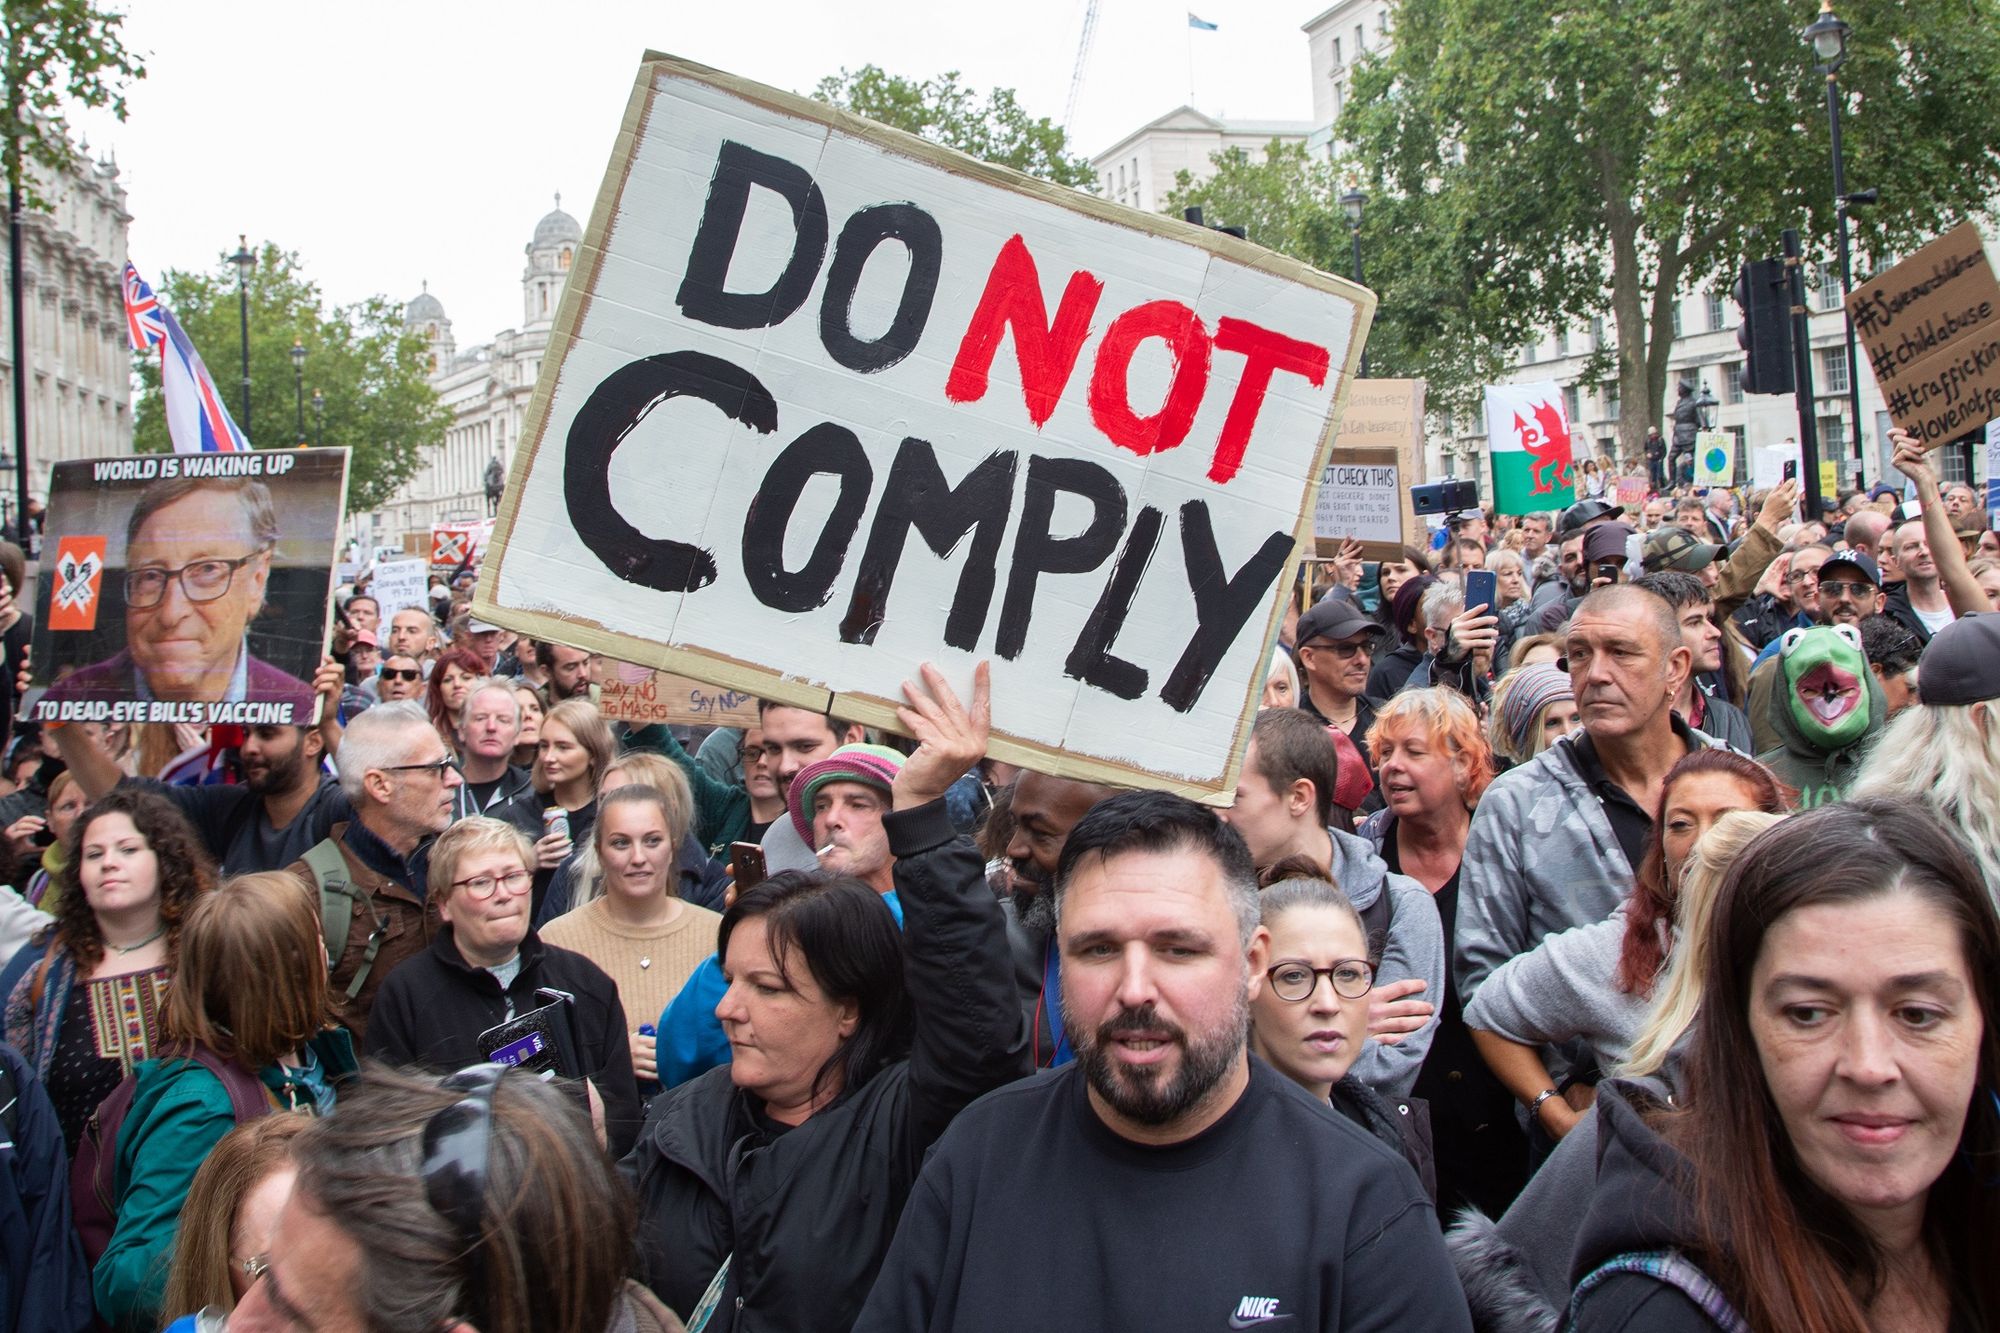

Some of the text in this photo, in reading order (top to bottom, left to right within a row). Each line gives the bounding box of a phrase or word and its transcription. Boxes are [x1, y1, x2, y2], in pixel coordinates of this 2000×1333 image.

[676, 140, 1330, 485] DO NOT
[1871, 302, 1993, 381] #childabuse
[1888, 342, 2000, 420] #traffickin
[1904, 388, 2000, 442] #lovenotfe
[94, 454, 295, 481] WORLD IS WAKING UP
[1321, 467, 1335, 485] CT
[1337, 467, 1368, 487] CHECK
[1371, 468, 1394, 488] THIS
[1318, 491, 1329, 500] ACT
[564, 350, 1296, 714] COMPLY
[601, 678, 656, 702] SAY NO
[688, 689, 738, 717] SAY NO
[37, 700, 295, 725] TO DEAD-EYE BILL'S VACCINE
[621, 700, 668, 719] MASKS
[1237, 1295, 1280, 1318] NIKE
